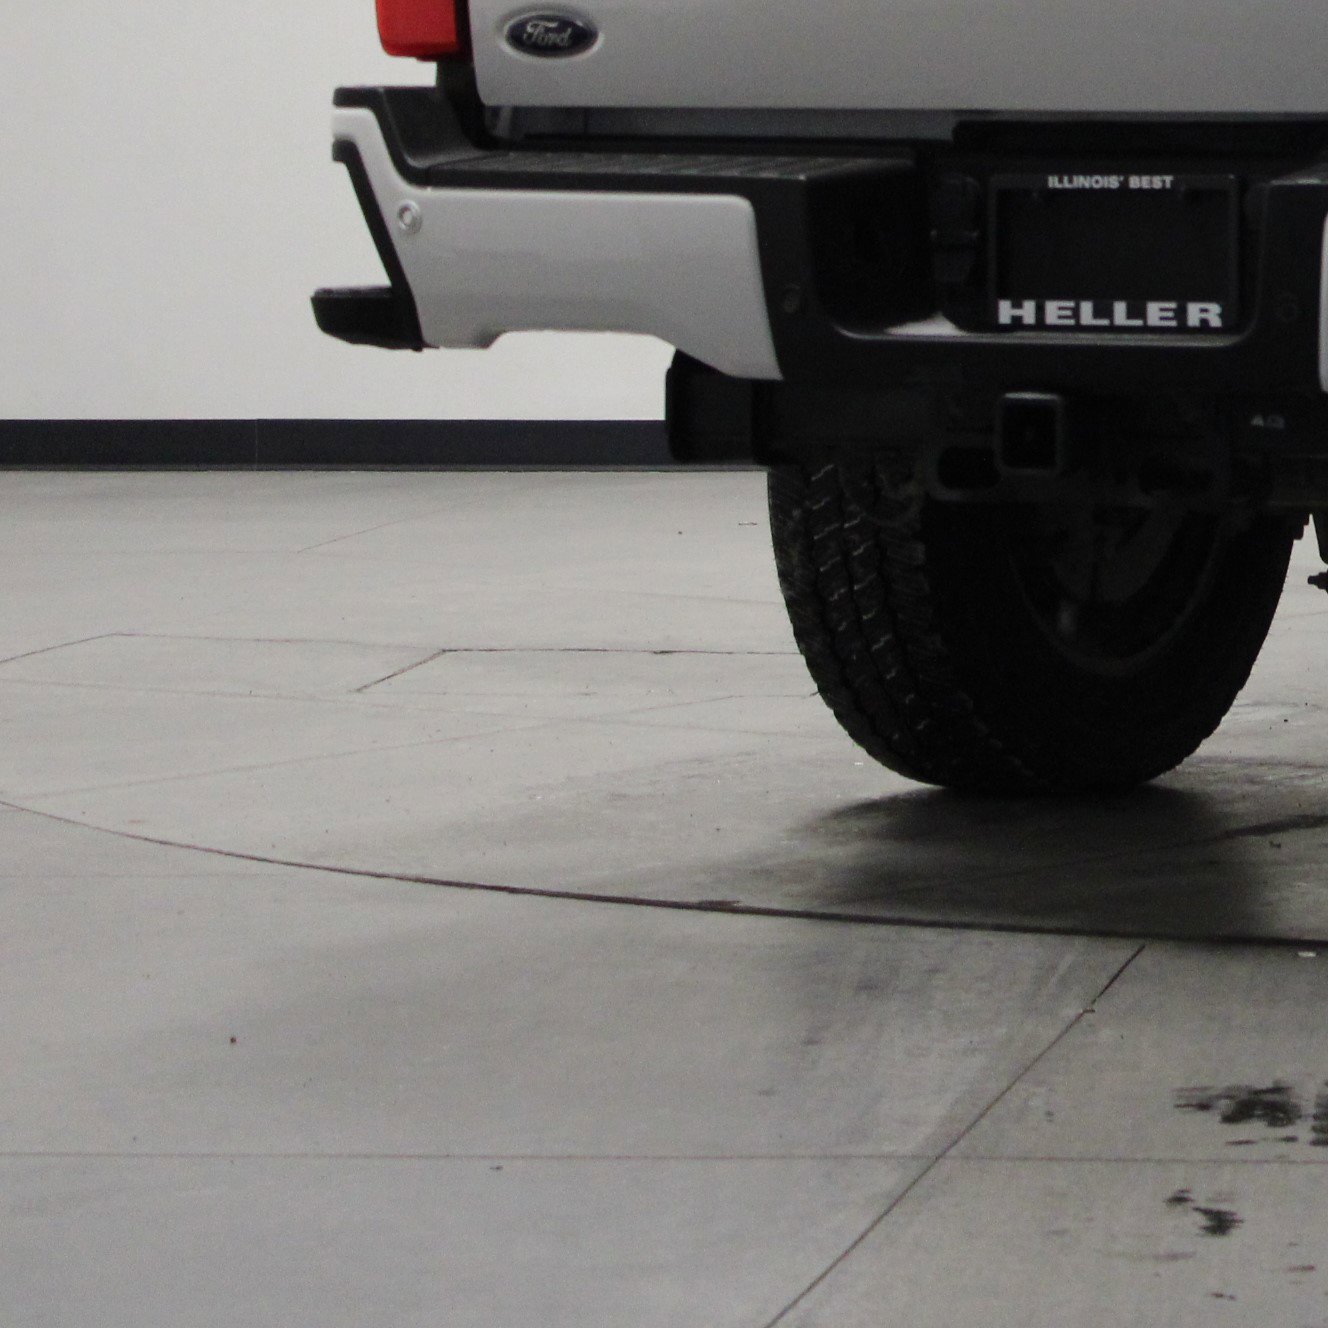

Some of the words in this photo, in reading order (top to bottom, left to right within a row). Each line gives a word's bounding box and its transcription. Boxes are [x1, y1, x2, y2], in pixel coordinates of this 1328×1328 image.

[1047, 174, 1125, 190] ILLINOIS'
[1128, 175, 1175, 190] BEST
[997, 299, 1223, 328] HELLER
